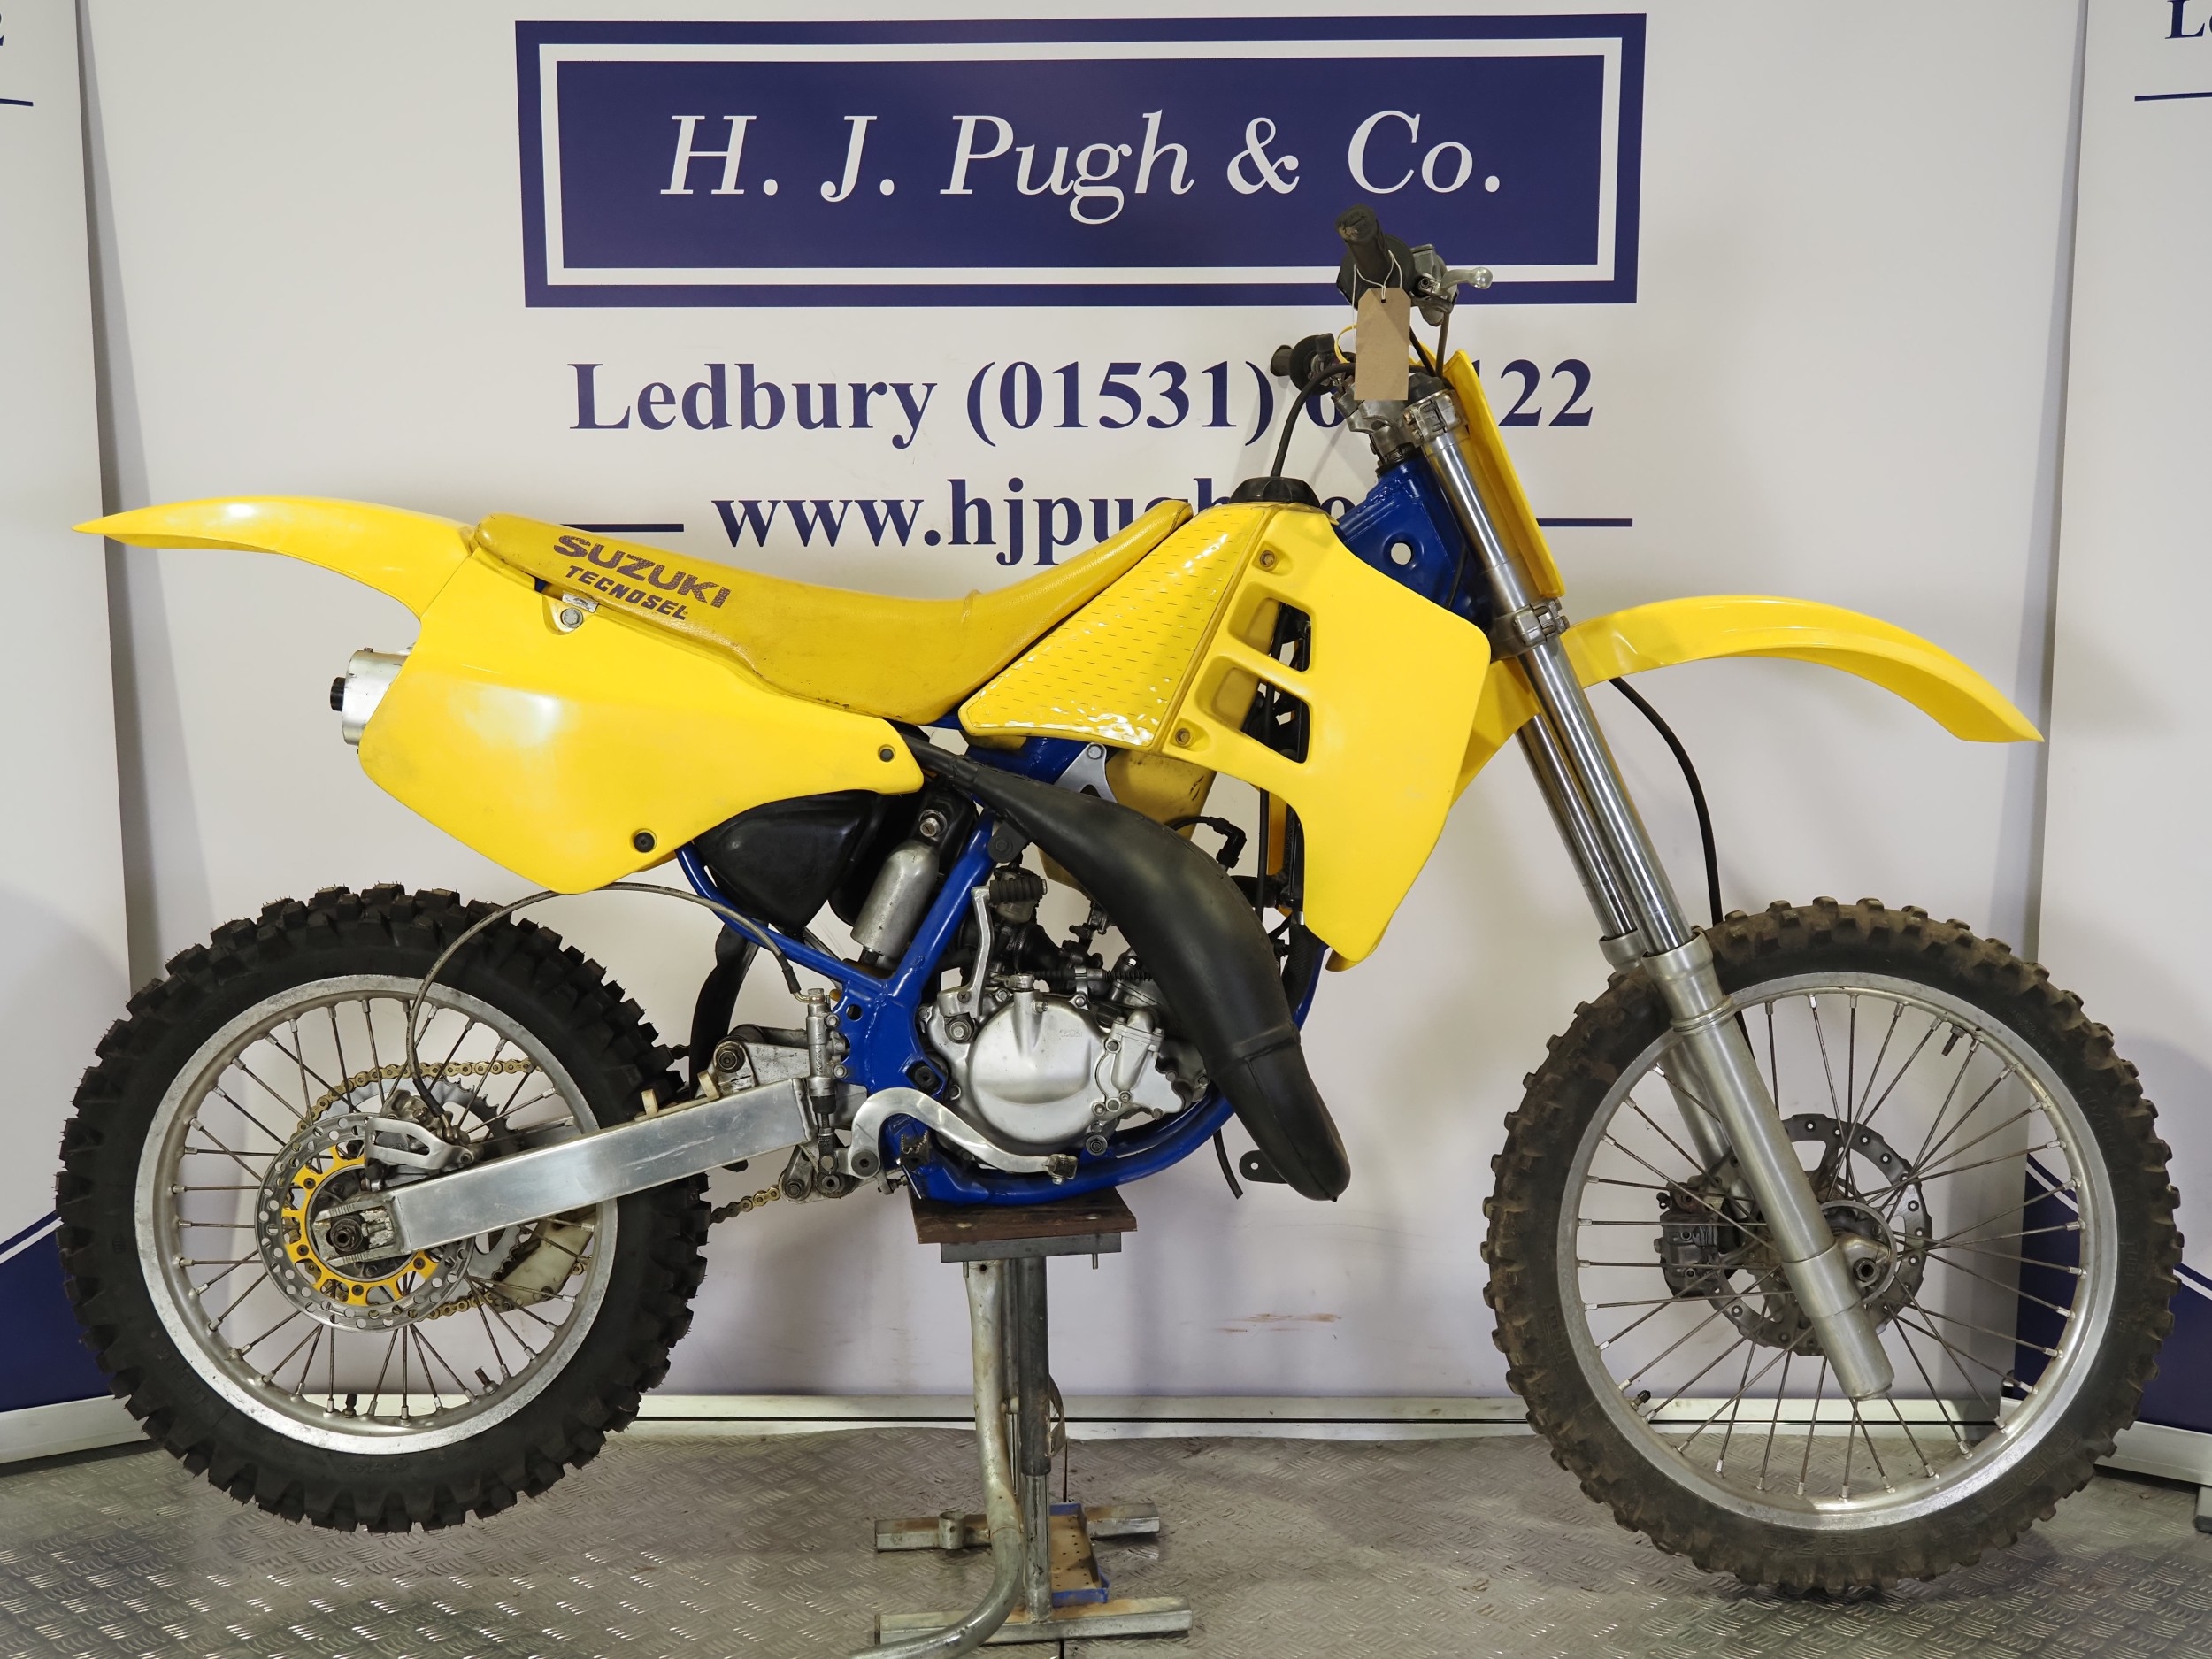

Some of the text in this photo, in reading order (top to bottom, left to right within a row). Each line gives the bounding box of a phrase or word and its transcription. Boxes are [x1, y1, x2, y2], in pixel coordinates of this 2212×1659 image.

[2165, 0, 2212, 39] L
[660, 109, 1500, 225] H. J. Pugh & Co.
[567, 363, 939, 449] Ledbury
[966, 359, 1275, 448] (01531)
[553, 534, 732, 609] SUZUKI
[565, 565, 687, 620] TECNOSEL
